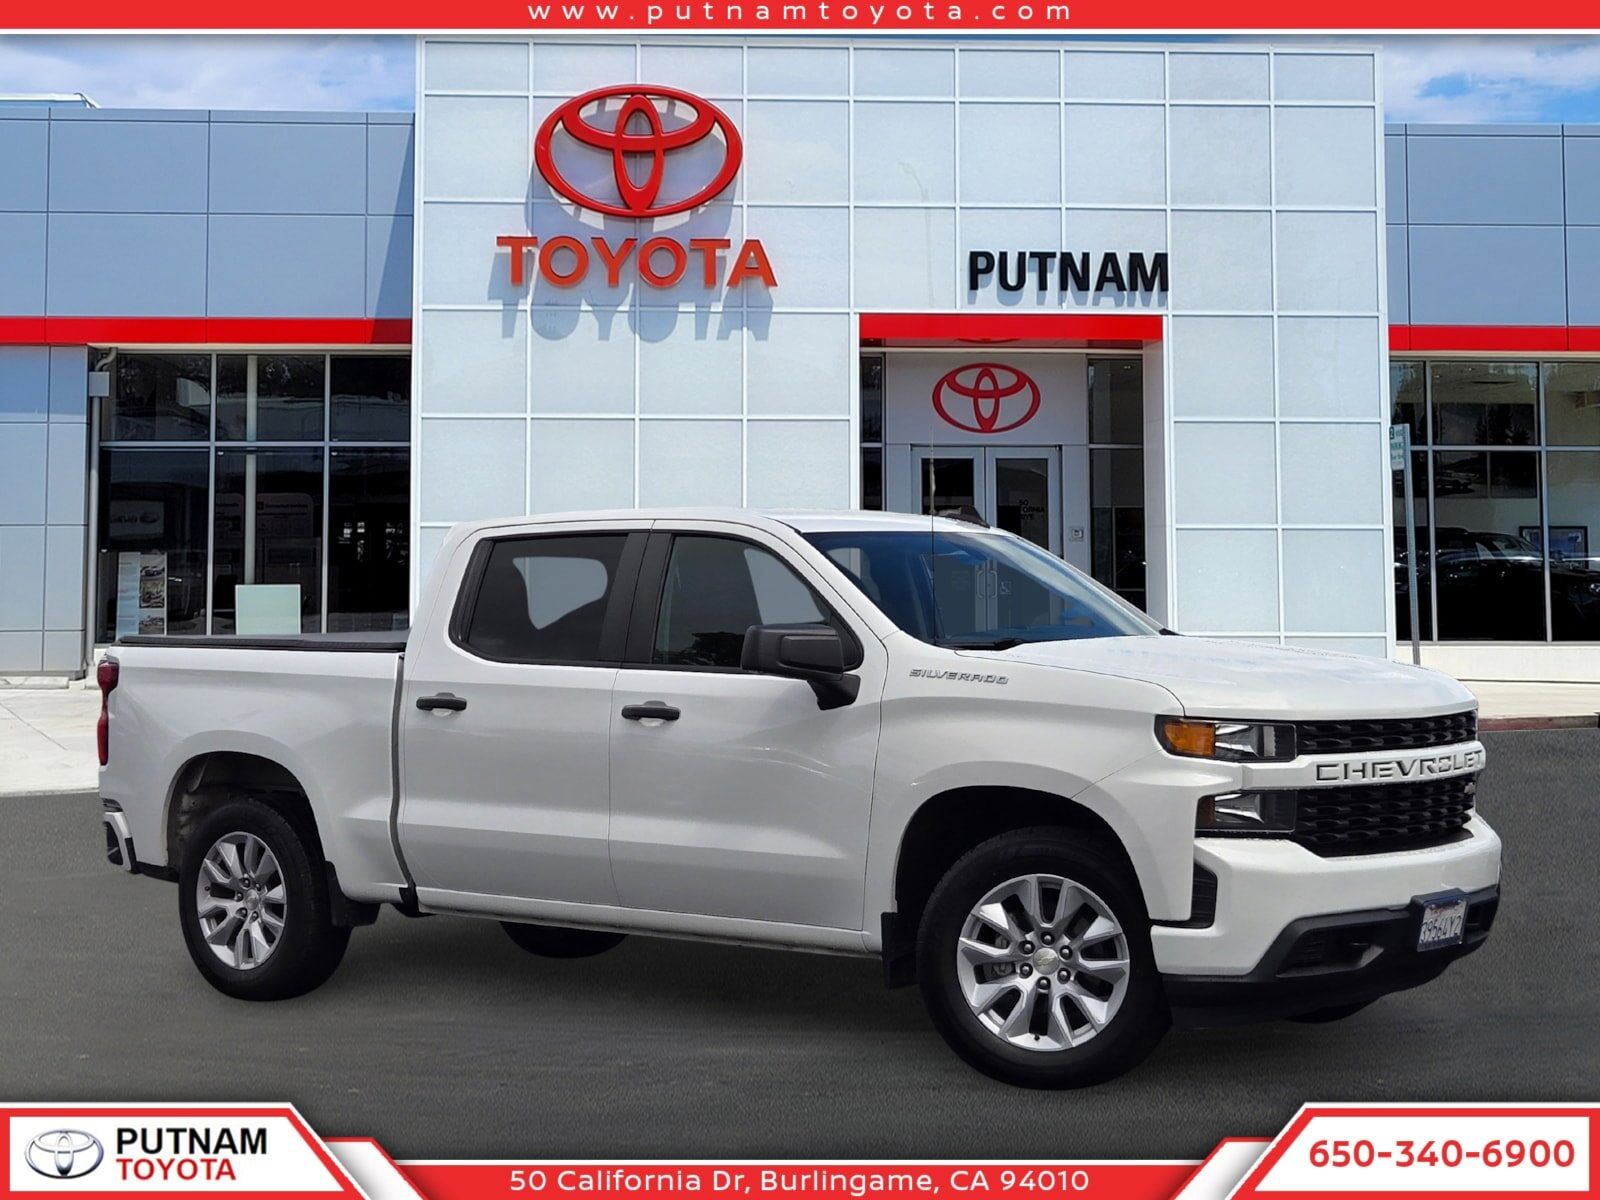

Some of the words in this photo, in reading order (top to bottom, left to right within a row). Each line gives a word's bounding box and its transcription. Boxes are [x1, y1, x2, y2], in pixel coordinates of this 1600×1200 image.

[496, 236, 777, 288] TOYOTA
[969, 251, 1169, 293] PUTNAM
[908, 669, 1009, 686] SILVERADO
[1316, 749, 1483, 783] CHEVROLET
